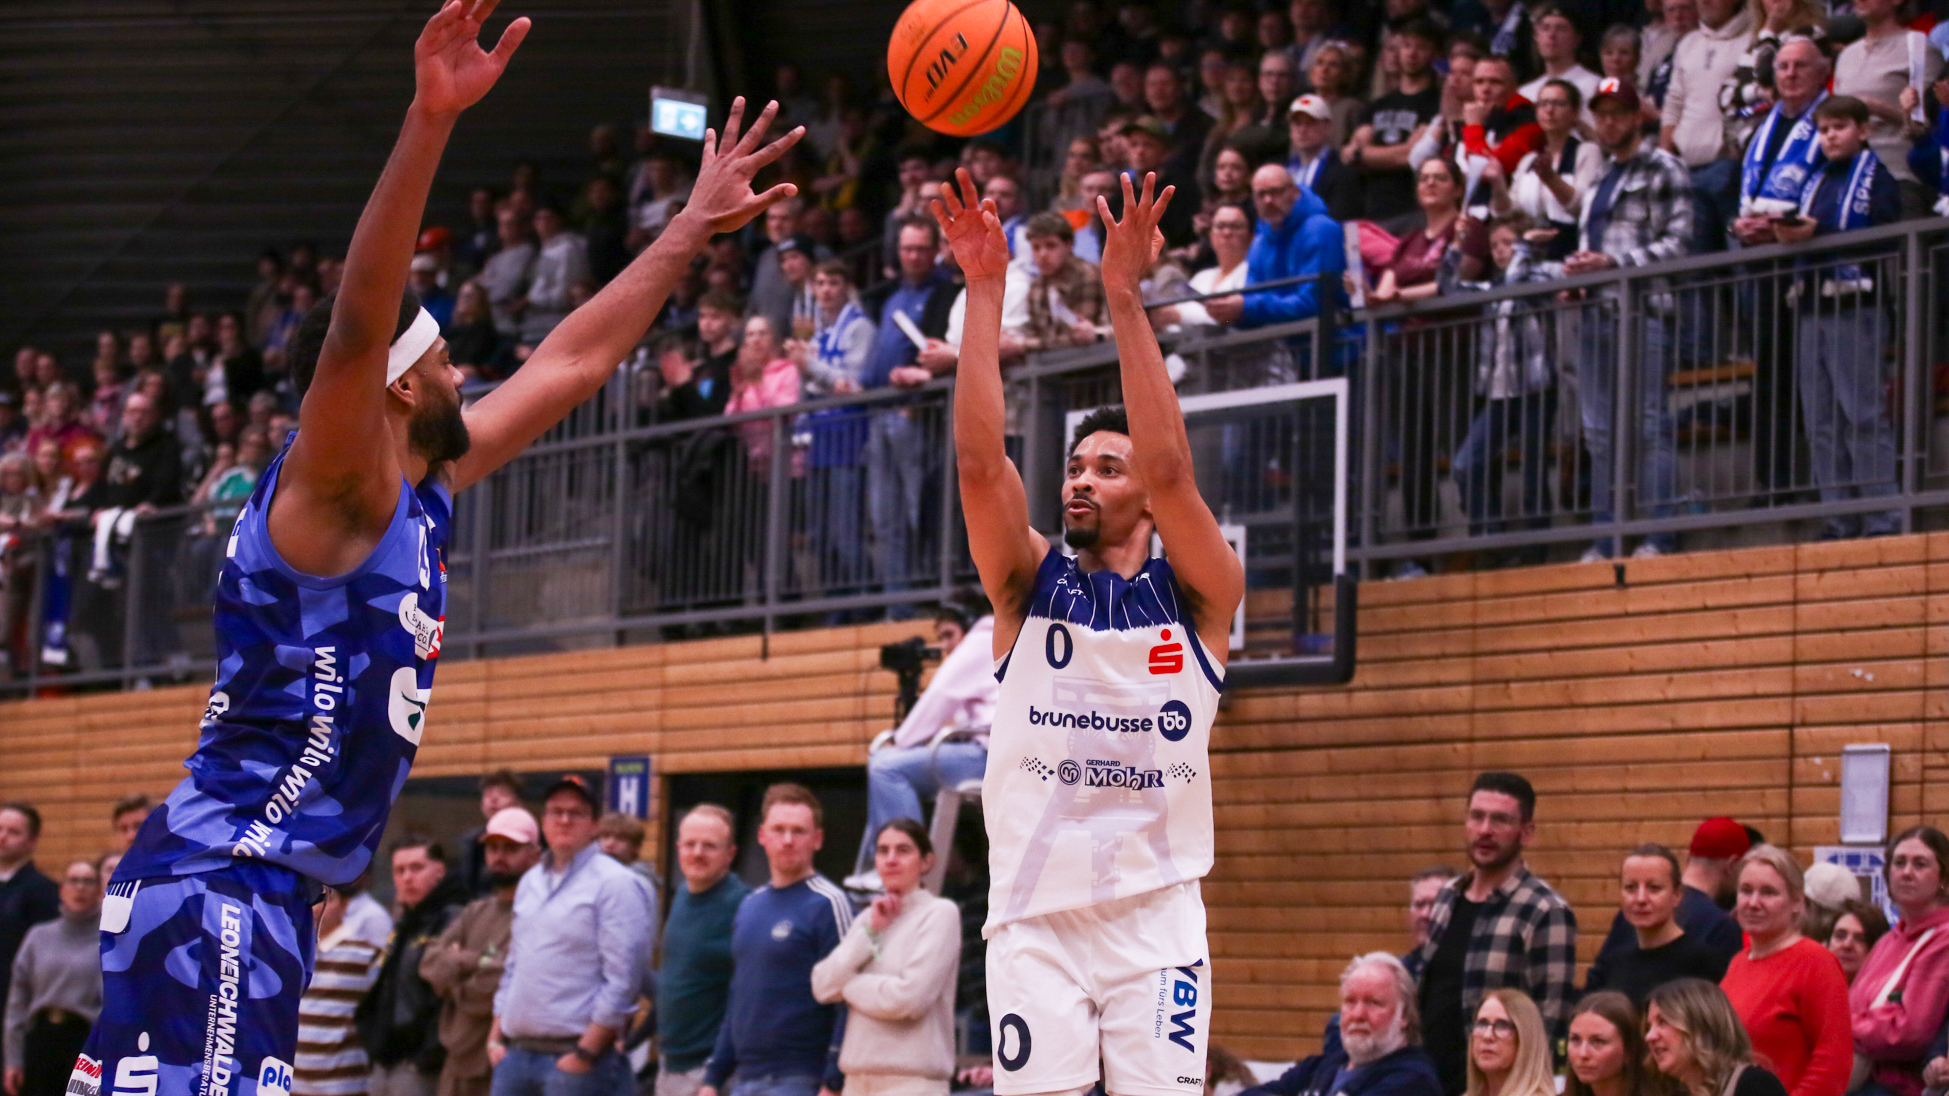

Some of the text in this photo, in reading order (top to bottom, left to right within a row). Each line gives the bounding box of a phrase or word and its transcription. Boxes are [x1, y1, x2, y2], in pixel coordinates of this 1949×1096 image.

[1045, 623, 1073, 670] 0
[314, 646, 344, 711] wilo
[300, 715, 335, 768] wilo
[1029, 705, 1154, 733] brunebusse
[1086, 759, 1121, 767] GERHARD
[265, 764, 312, 825] wilo
[1157, 988, 1168, 1006] fürs
[997, 1013, 1031, 1072] 0
[1154, 1008, 1165, 1039] Leben
